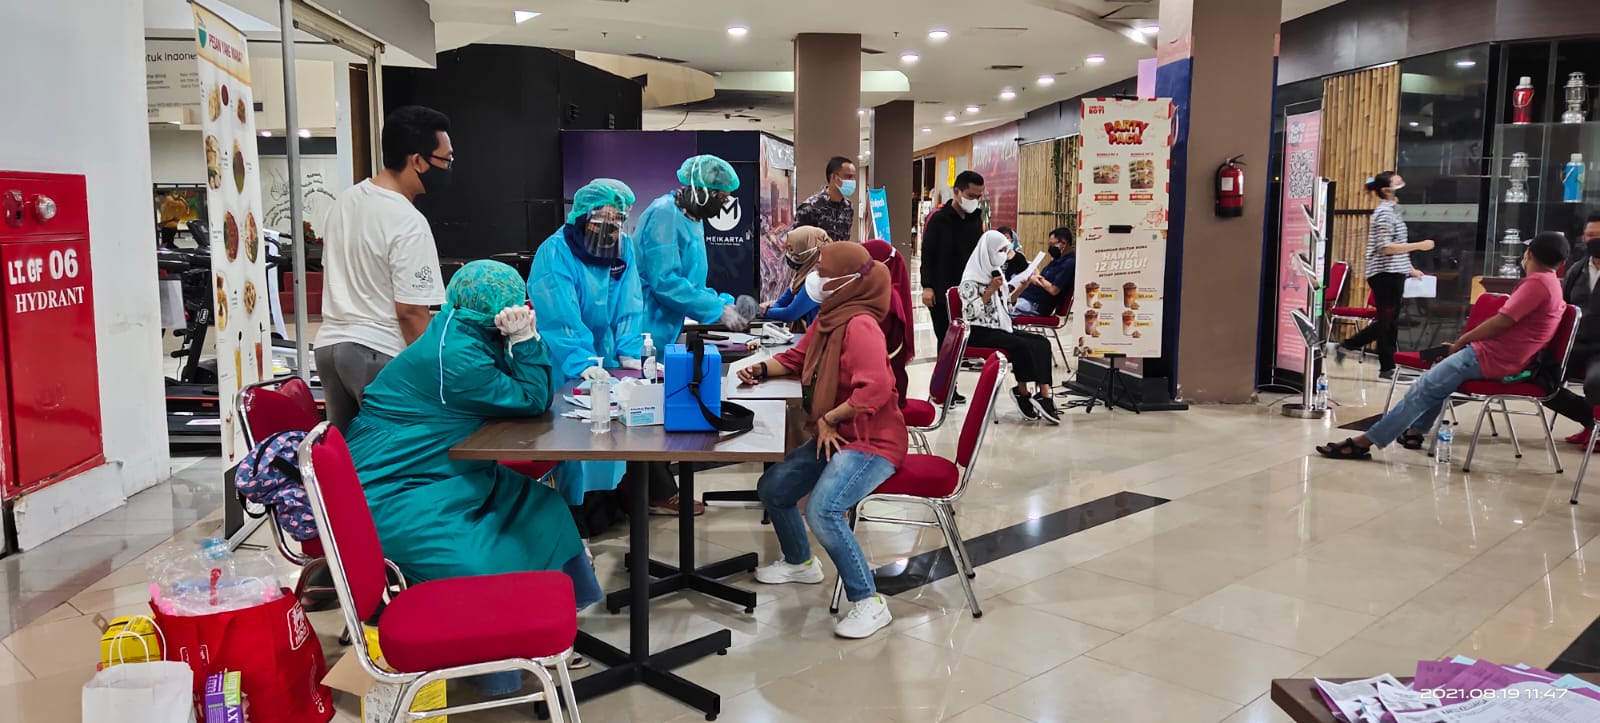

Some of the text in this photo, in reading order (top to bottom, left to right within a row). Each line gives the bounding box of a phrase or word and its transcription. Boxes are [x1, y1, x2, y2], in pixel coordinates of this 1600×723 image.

[1104, 119, 1149, 137] PARTY
[1108, 132, 1143, 145] PACK
[49, 248, 79, 280] 06
[1103, 251, 1139, 261] HANYA
[1095, 257, 1149, 272] 12 RIBU!
[15, 286, 85, 314] HYDRANT
